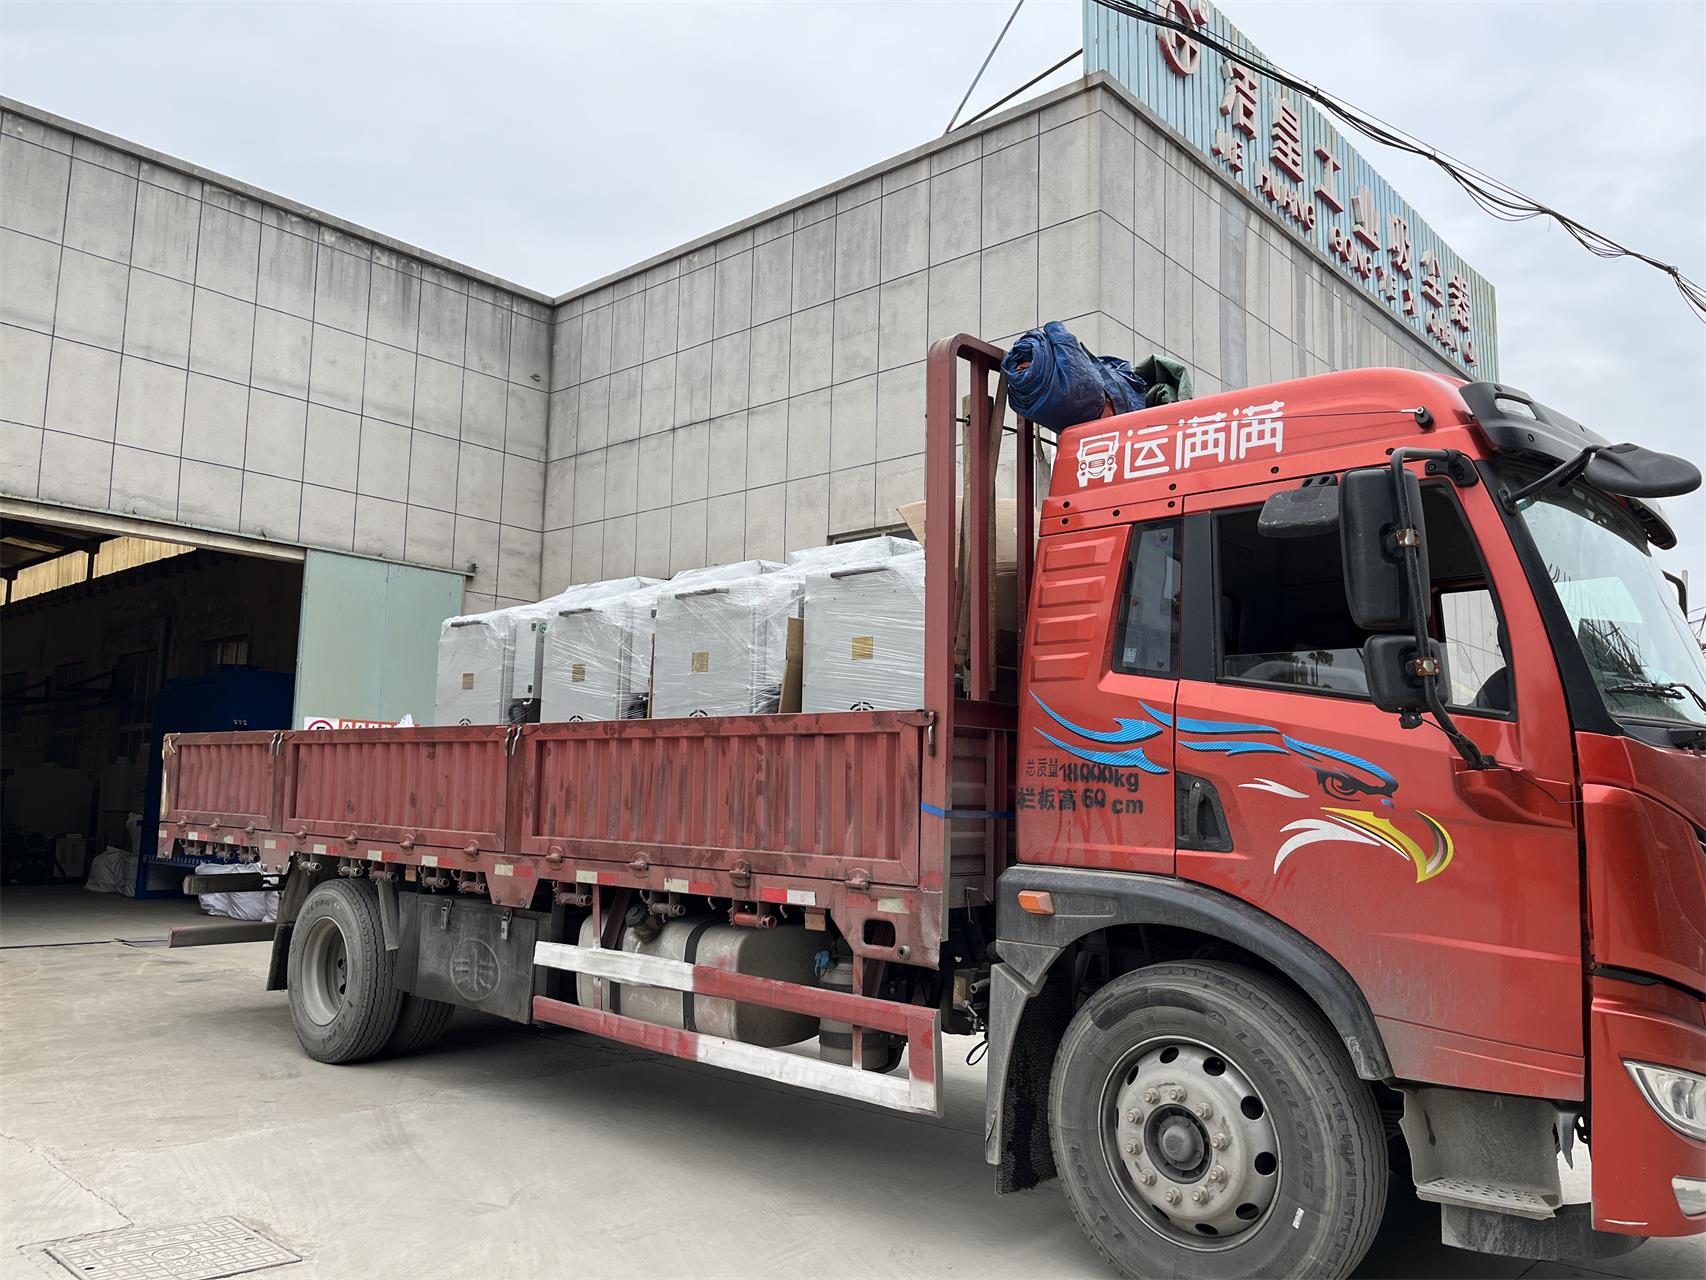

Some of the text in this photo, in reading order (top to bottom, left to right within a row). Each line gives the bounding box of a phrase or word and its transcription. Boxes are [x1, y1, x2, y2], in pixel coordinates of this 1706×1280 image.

[1253, 160, 1316, 232] HUANG
[1328, 226, 1372, 280] GONG
[1124, 400, 1285, 480] 运满满
